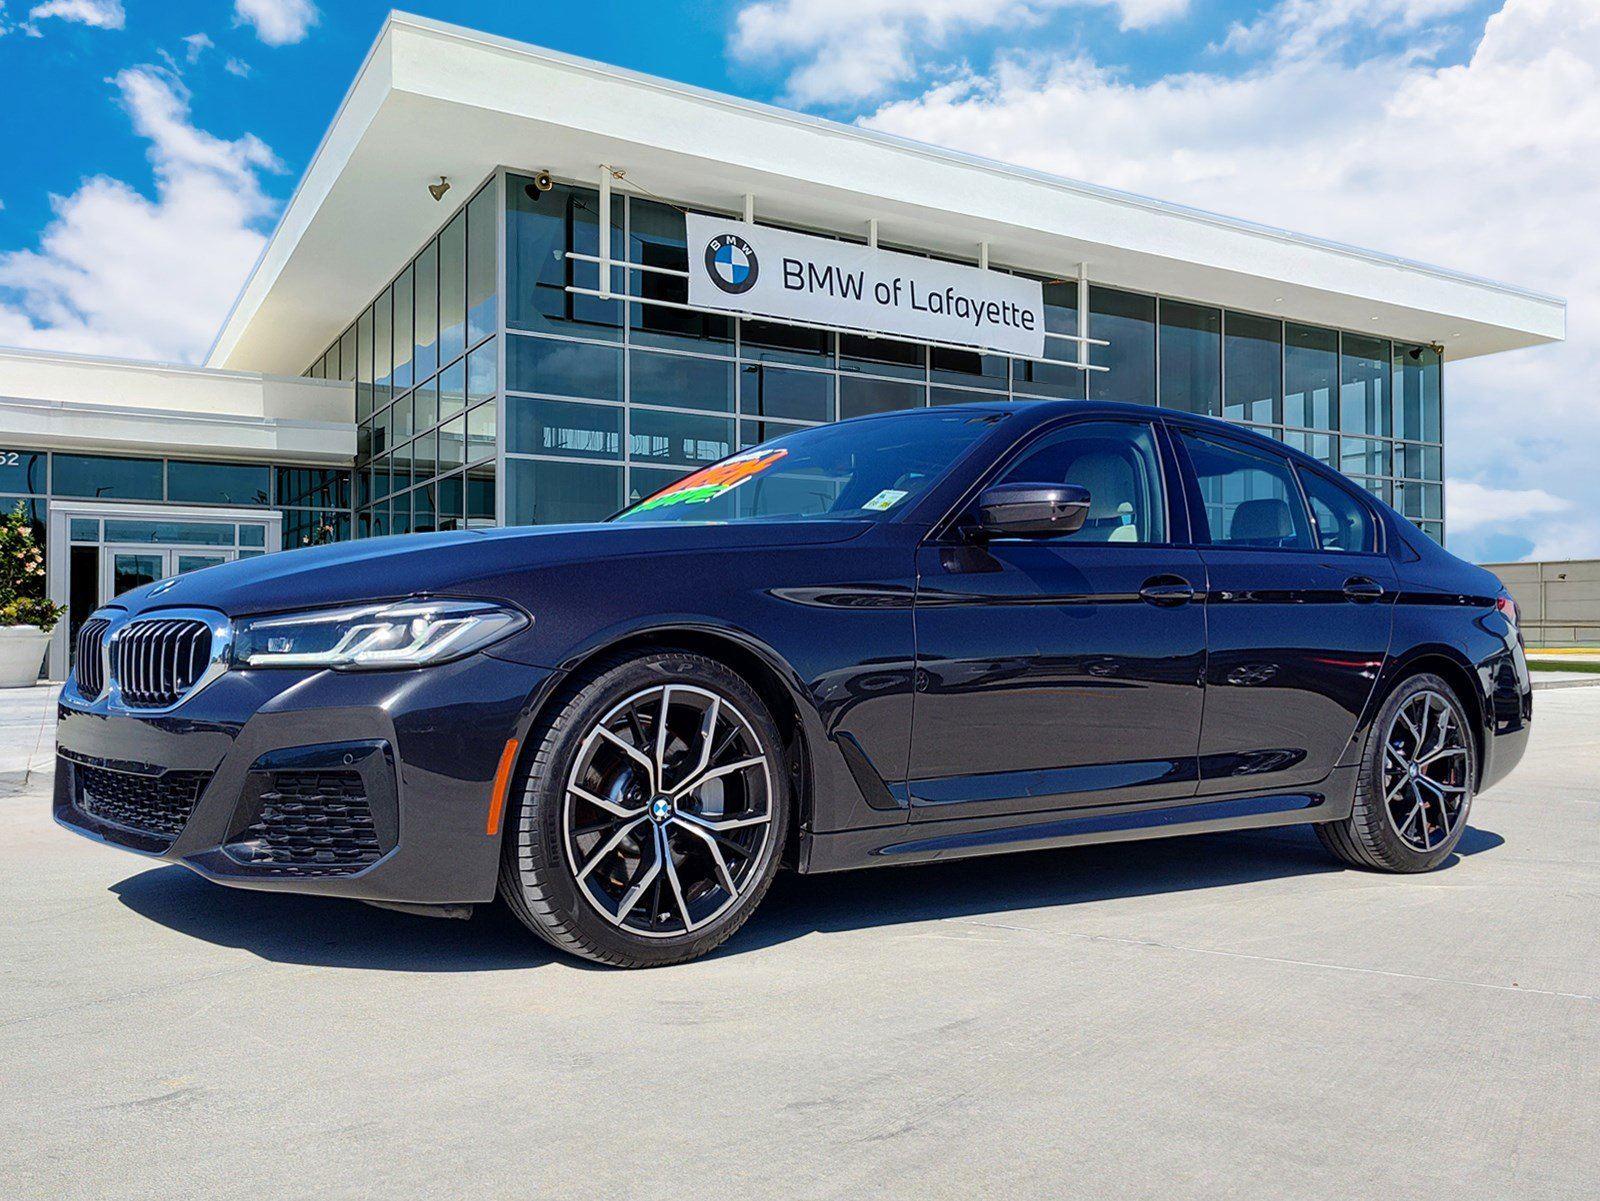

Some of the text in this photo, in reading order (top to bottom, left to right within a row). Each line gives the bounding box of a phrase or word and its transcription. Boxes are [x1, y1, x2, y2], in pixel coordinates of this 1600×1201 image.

[710, 235, 752, 255] BMW
[783, 257, 1035, 331] BMW of Lafayette
